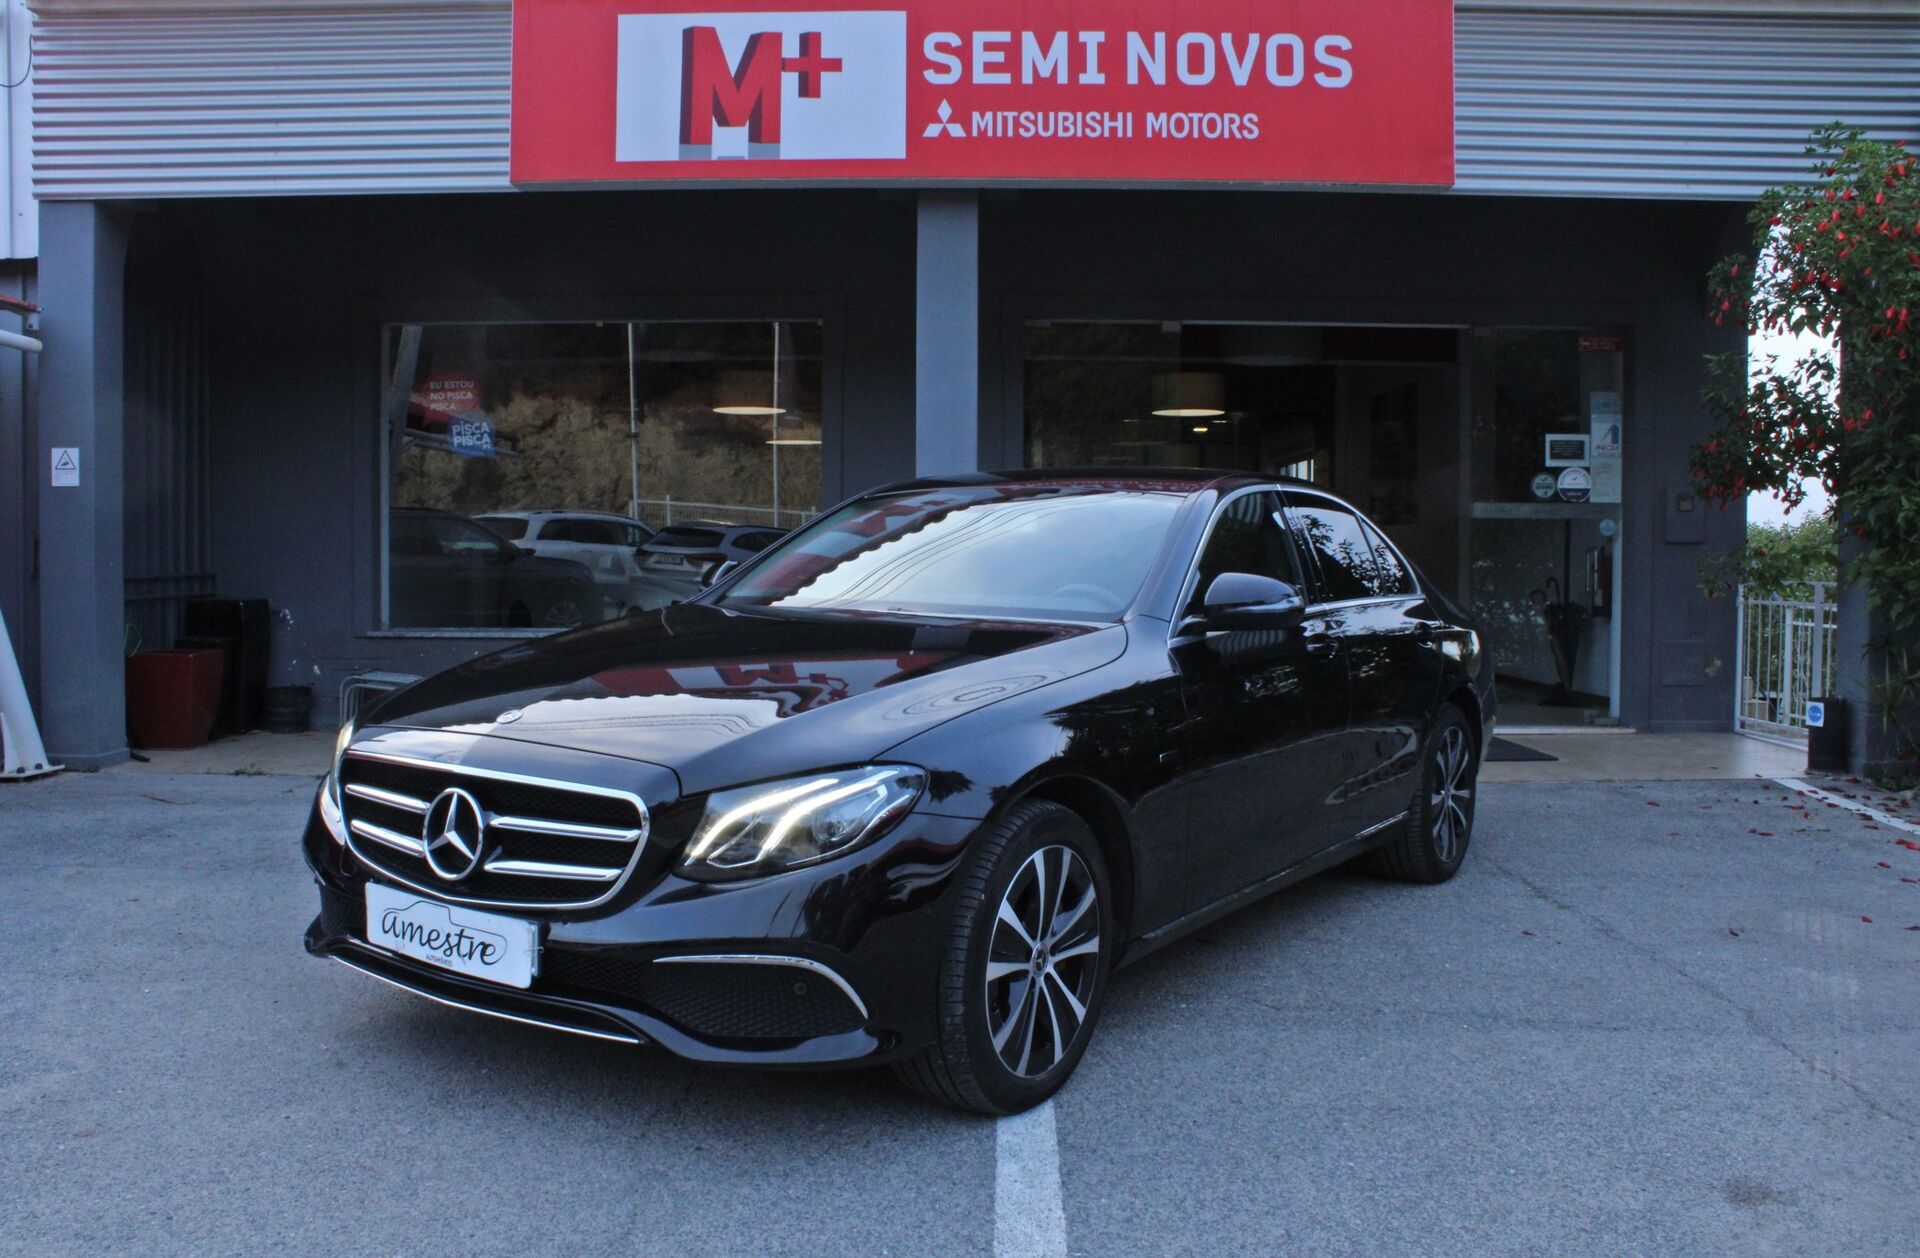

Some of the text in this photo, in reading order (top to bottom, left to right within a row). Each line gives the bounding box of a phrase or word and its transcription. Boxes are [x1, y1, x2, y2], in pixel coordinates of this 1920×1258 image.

[923, 31, 1353, 88] SEMI NOVOS
[971, 111, 1259, 139] MITSUBISHI MOTORS
[430, 380, 474, 389] EU ESTOU
[430, 391, 473, 400] NO PISCA
[430, 402, 456, 411] PISCA
[452, 421, 490, 436] PISCA
[453, 434, 491, 448] PISCA
[382, 911, 496, 966] amestre
